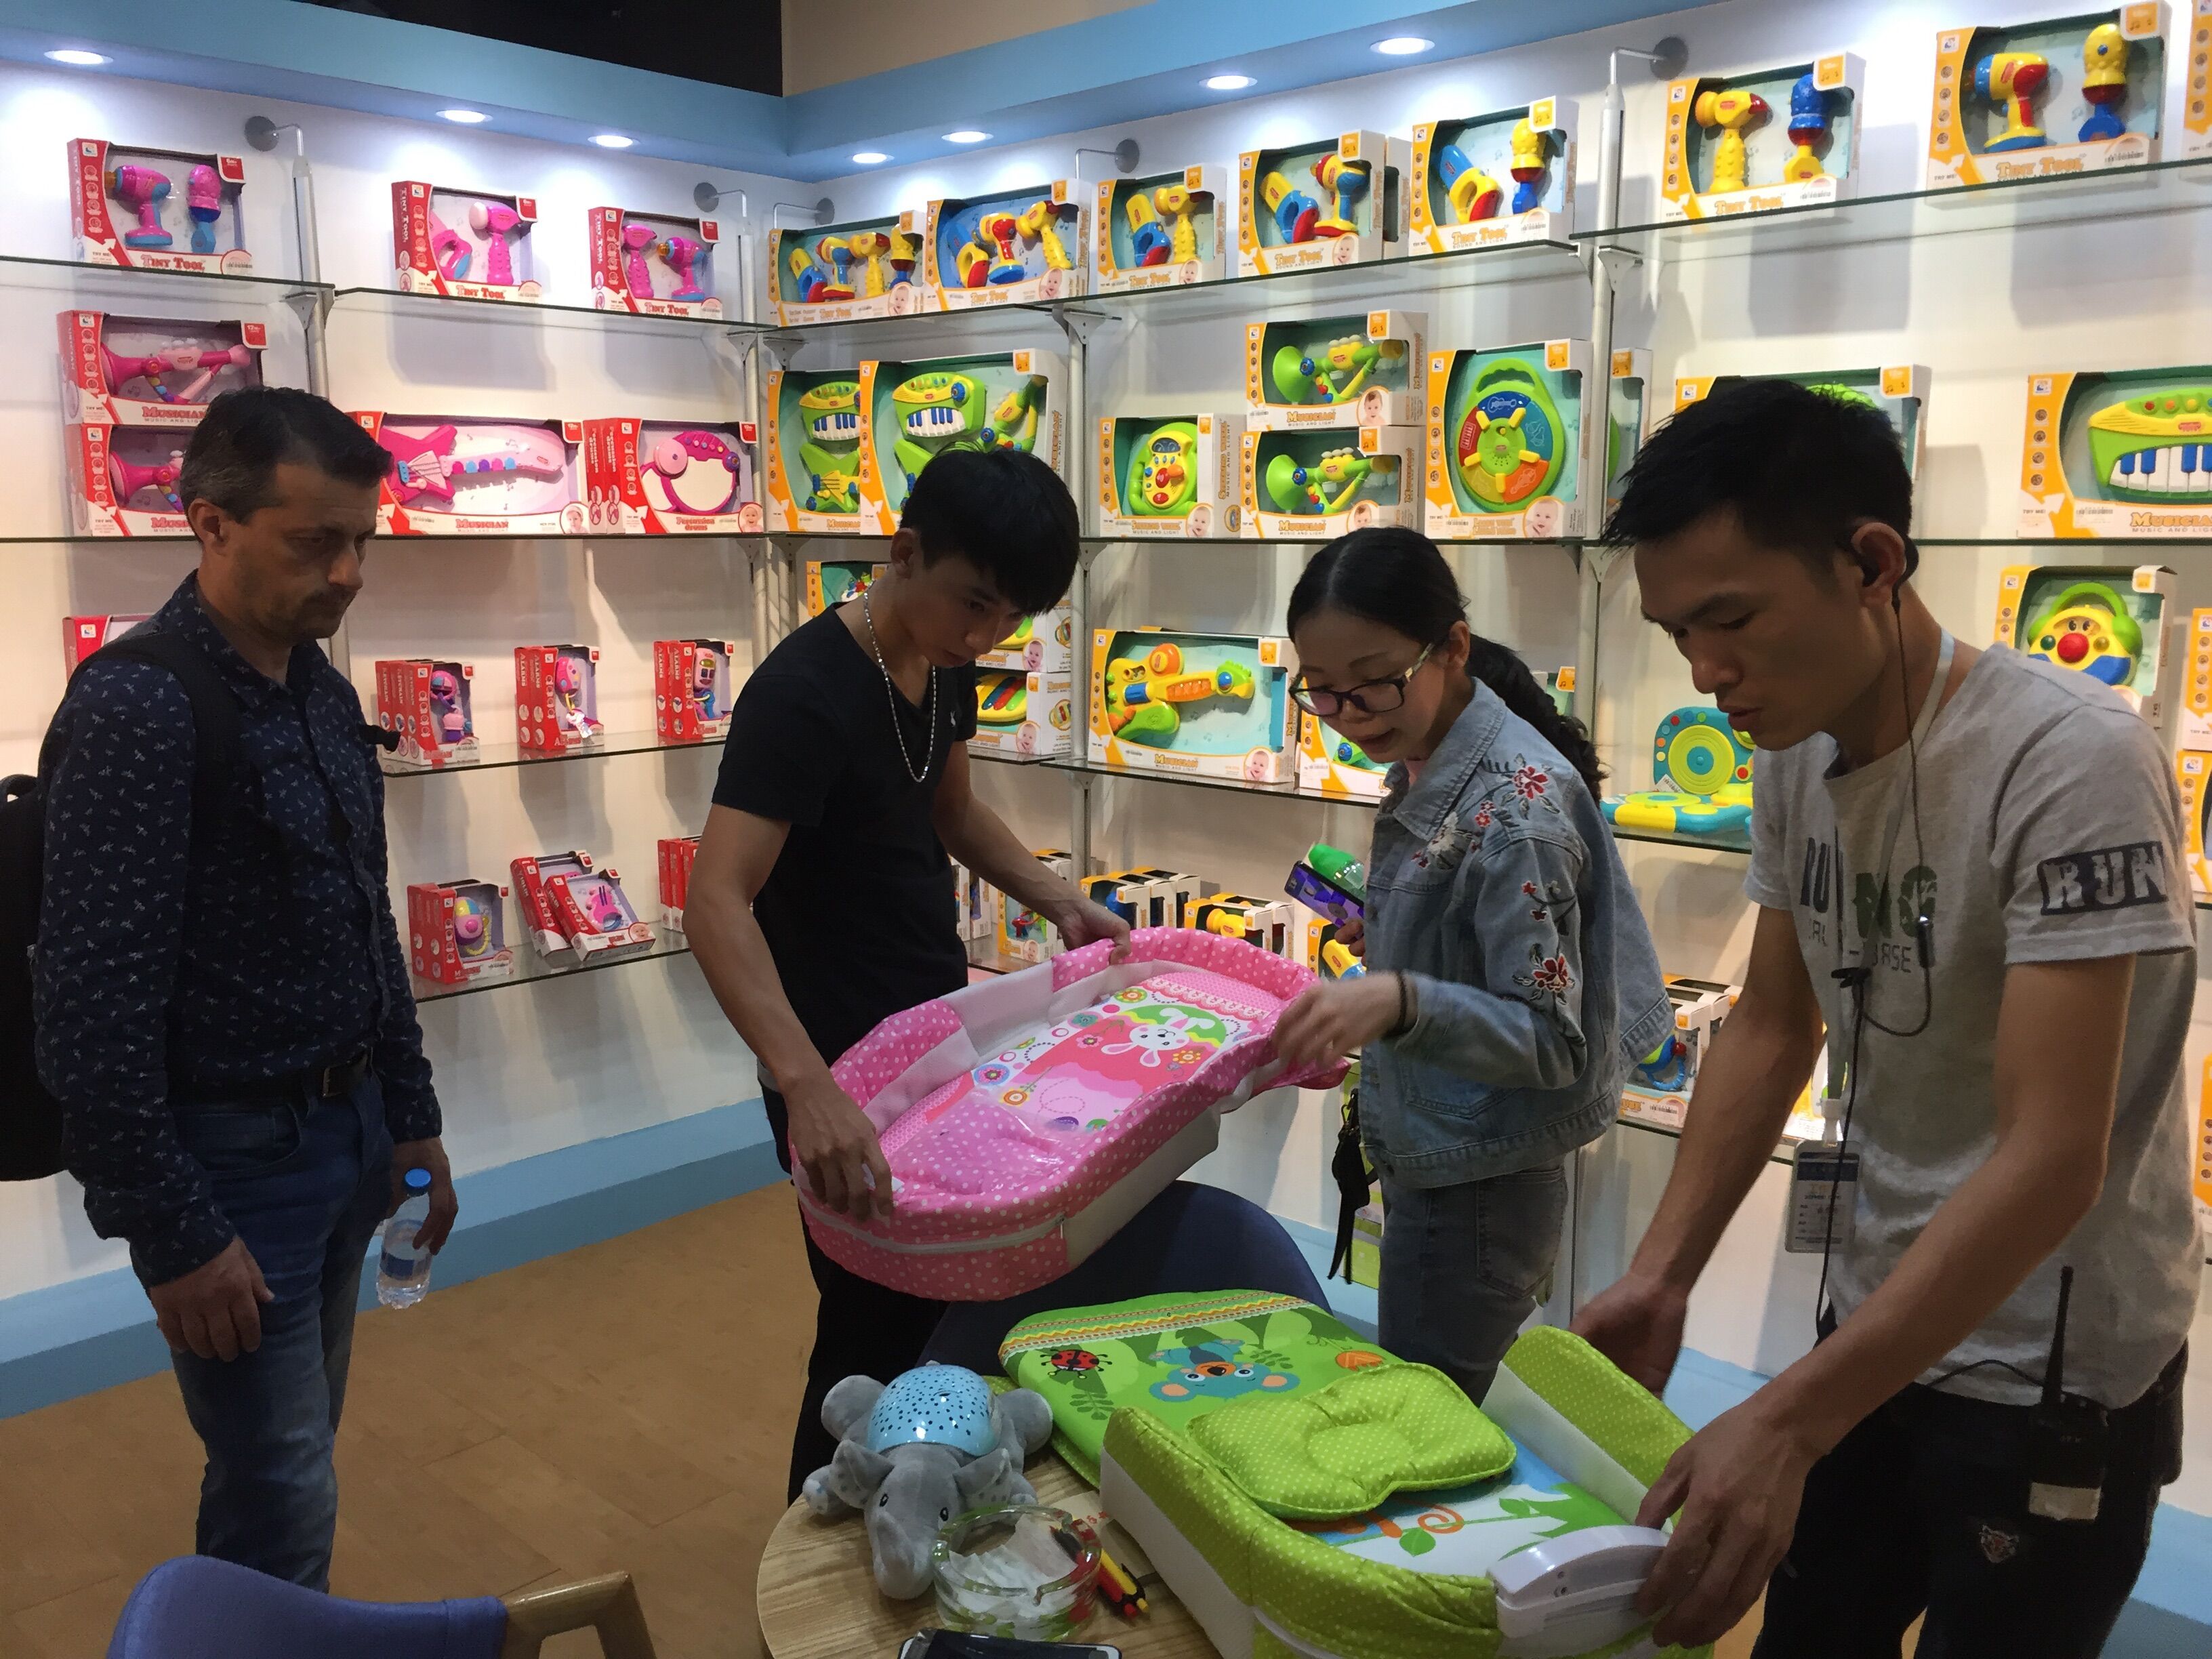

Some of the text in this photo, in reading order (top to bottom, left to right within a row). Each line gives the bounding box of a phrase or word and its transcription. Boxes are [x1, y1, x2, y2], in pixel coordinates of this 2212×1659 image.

[1996, 157, 2085, 178] TINY TOOL
[1715, 195, 1784, 215] TINY TOOL
[140, 254, 205, 270] TINY TOOL
[455, 285, 506, 300] TINY TOOL
[644, 302, 689, 315] TINY TOOL
[455, 518, 509, 529] MUSICIAN
[2043, 846, 2167, 909] RUN
